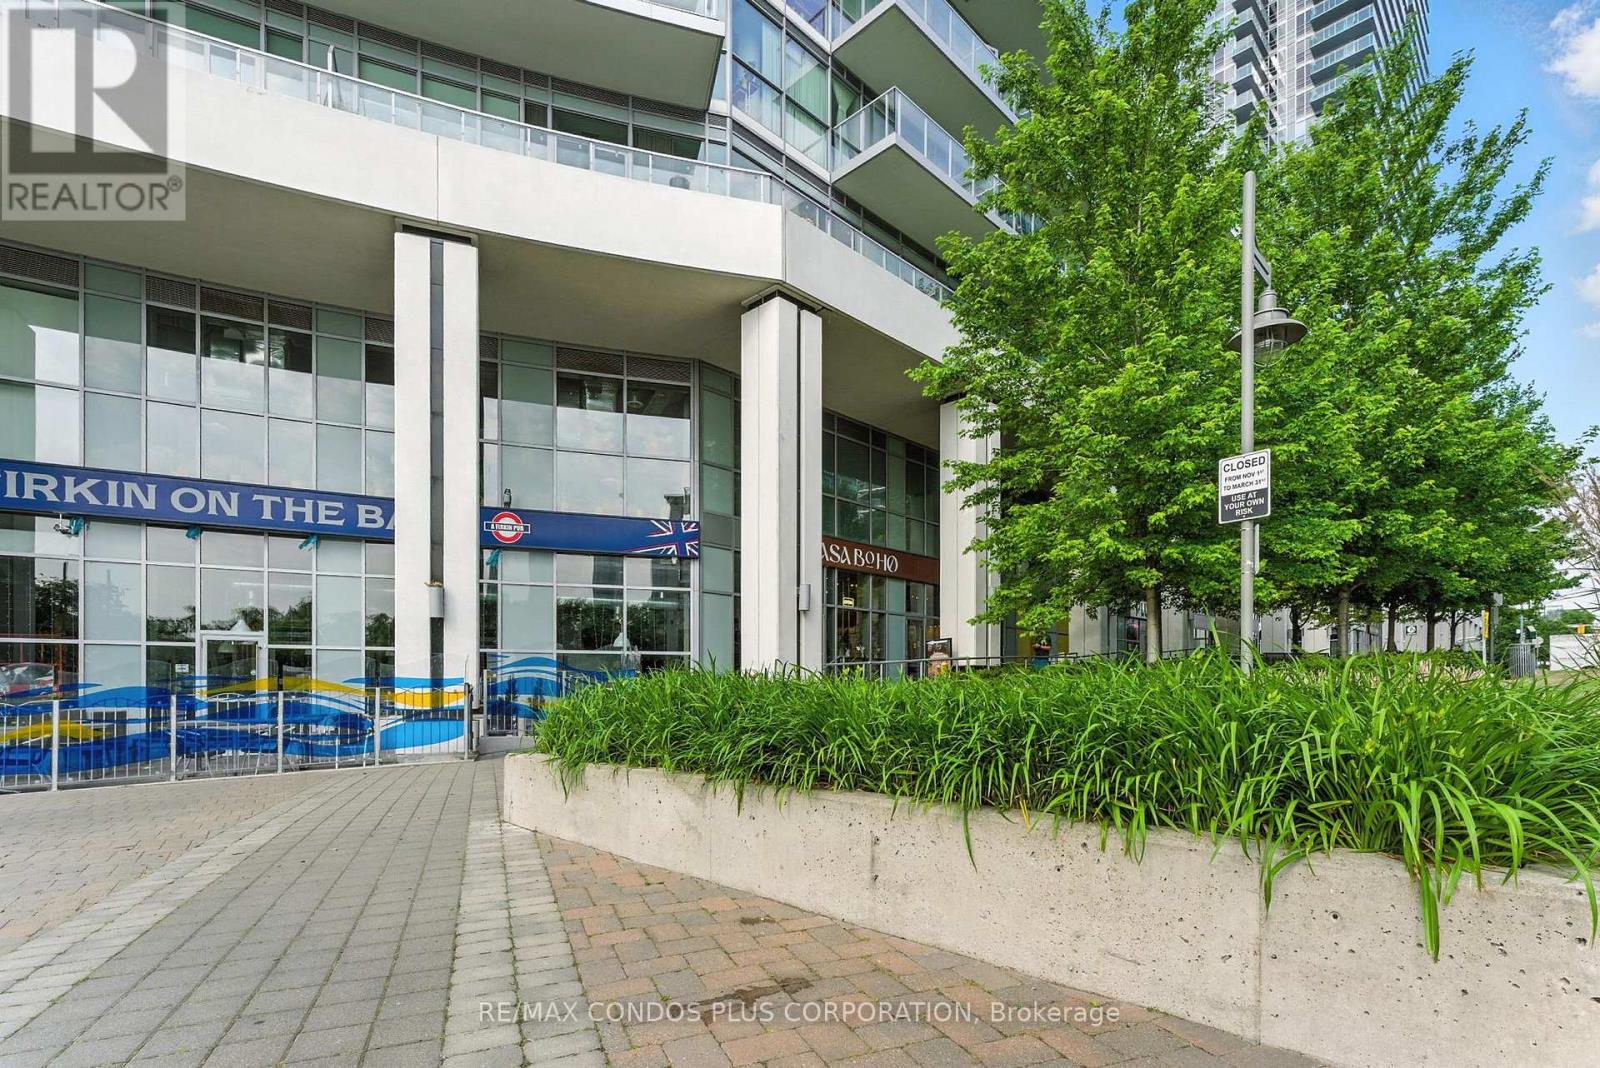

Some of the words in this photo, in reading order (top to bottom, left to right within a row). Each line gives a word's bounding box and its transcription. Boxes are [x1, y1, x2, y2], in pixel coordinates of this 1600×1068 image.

[1223, 456, 1266, 473] CLOSED
[1224, 475, 1242, 483] FROM
[1242, 471, 1256, 480] NOV
[1232, 481, 1254, 490] MARCH
[0, 470, 156, 511] IRKIN
[170, 486, 239, 518] ON
[252, 494, 346, 527] THE
[1231, 494, 1246, 502] USE
[1247, 491, 1257, 499] AT
[1224, 502, 1245, 511] YOUR
[1246, 497, 1265, 507] OWN
[1235, 507, 1253, 516] RISK
